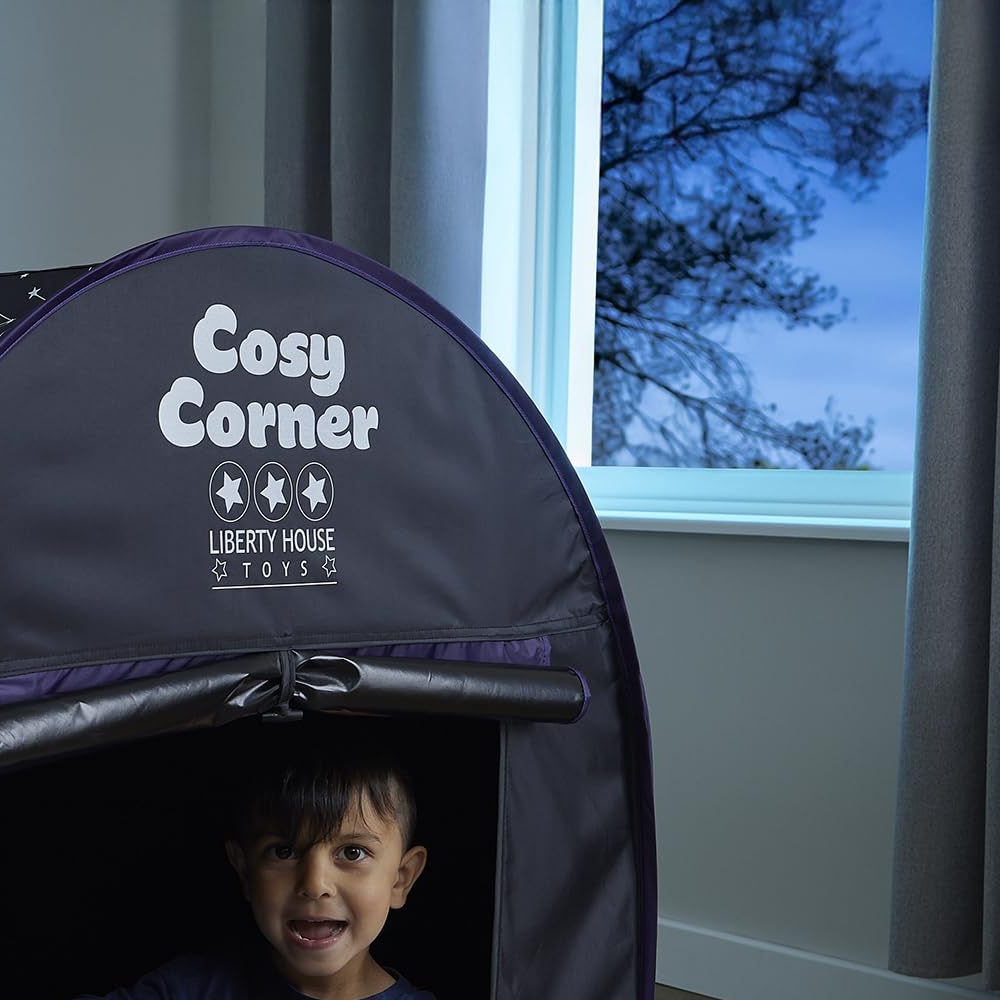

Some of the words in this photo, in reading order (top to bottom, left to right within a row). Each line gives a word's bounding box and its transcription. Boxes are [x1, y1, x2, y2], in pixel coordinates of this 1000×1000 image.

[192, 303, 346, 397] Cosy
[158, 376, 380, 450] Corner
[209, 529, 277, 554] LIBERTY
[282, 528, 336, 553] HOUSE
[242, 560, 308, 579] TOYS
